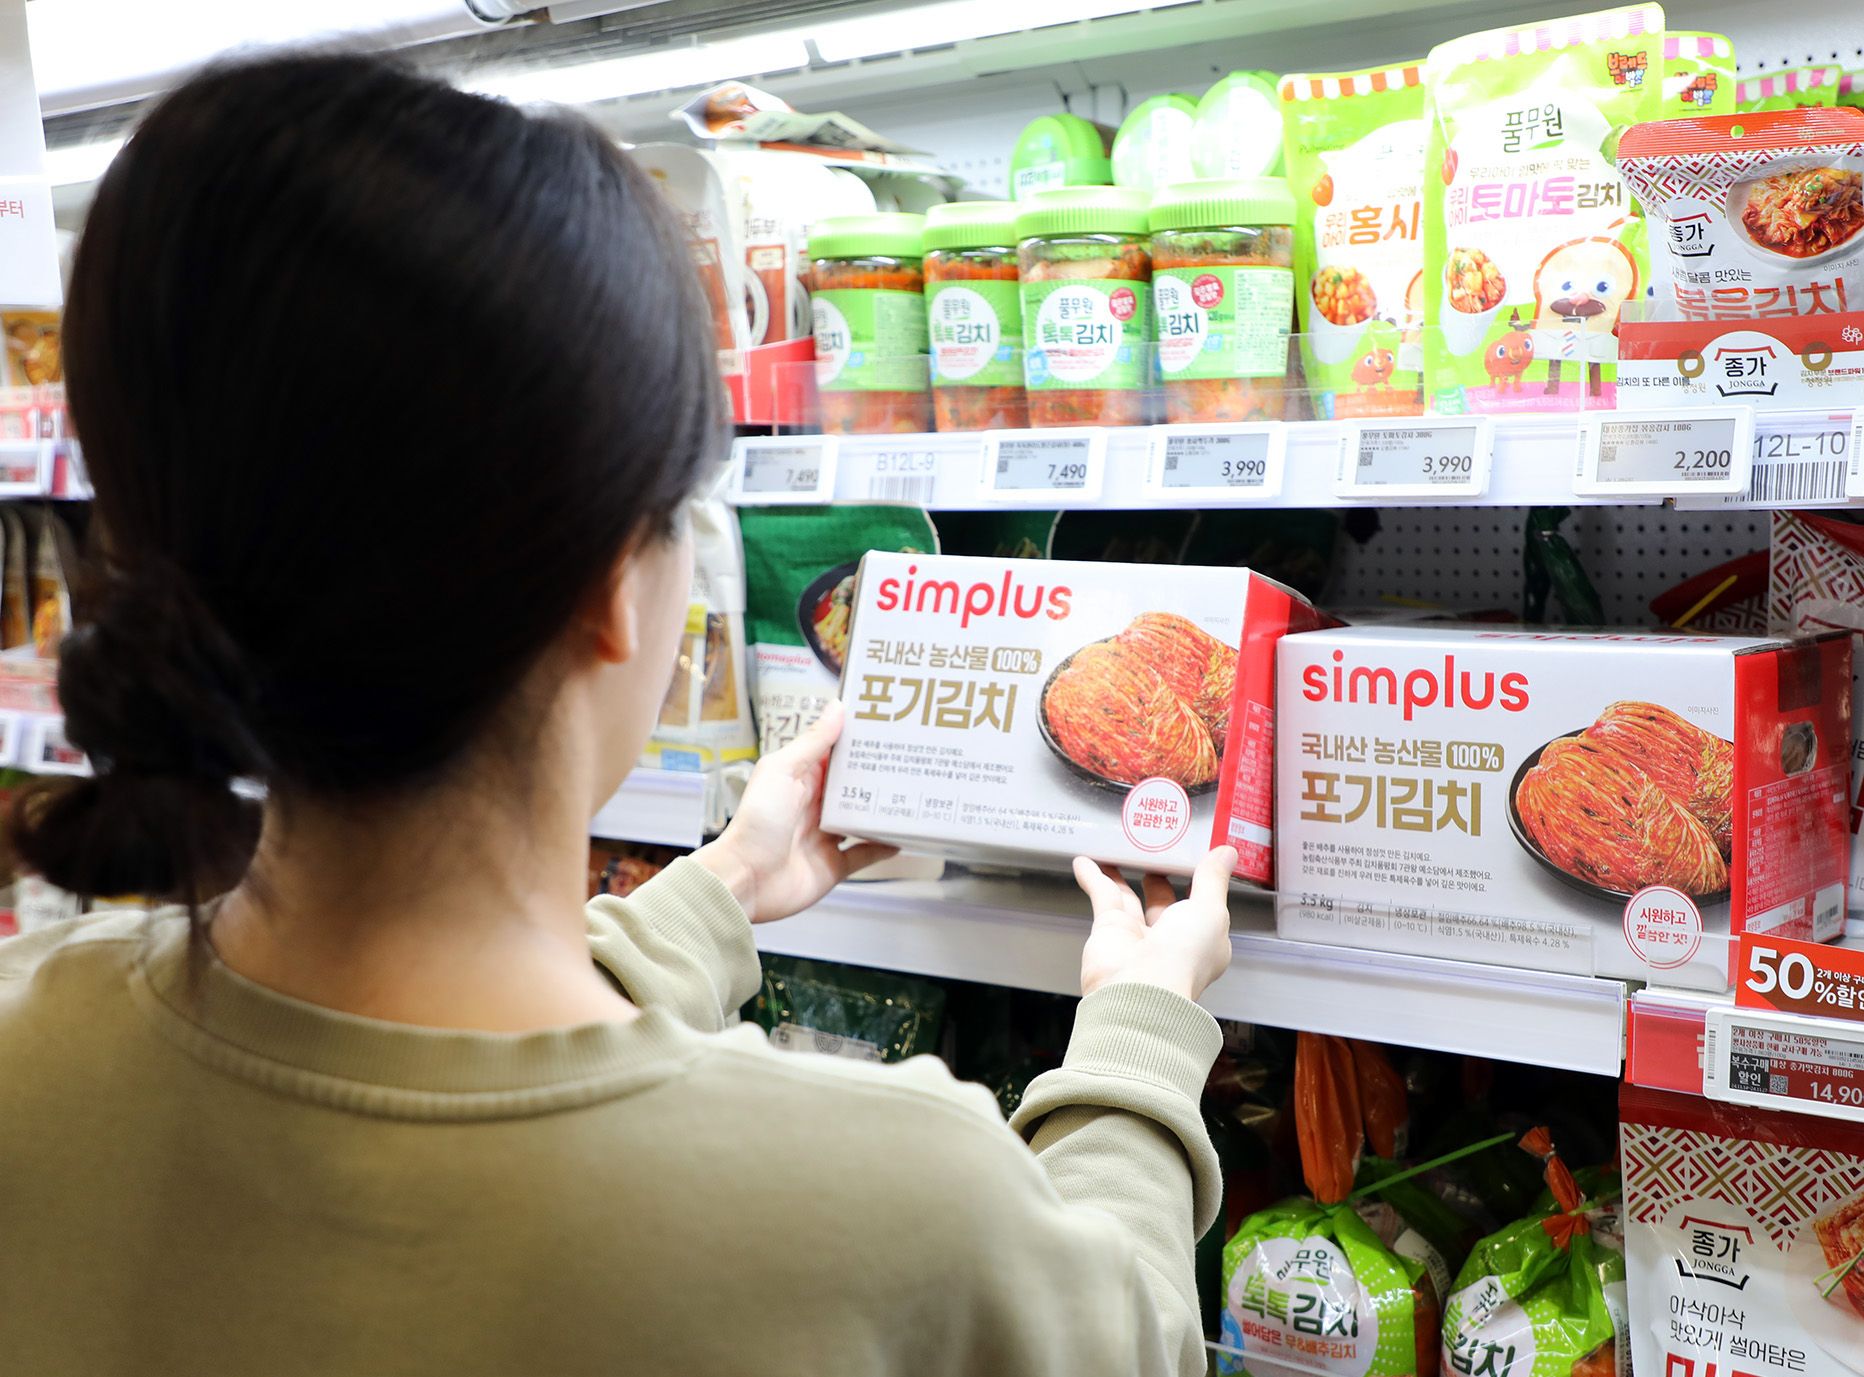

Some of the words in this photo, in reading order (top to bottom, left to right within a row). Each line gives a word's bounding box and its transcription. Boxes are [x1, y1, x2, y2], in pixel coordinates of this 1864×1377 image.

[1501, 103, 1563, 153] 풀무원
[1669, 222, 1705, 243] 종가
[1715, 267, 1753, 283] 맛있는
[1725, 356, 1767, 378] 종가
[1616, 376, 1640, 387] 김치의
[1642, 377, 1651, 387] 또
[1653, 377, 1672, 387] 다른
[1729, 379, 1766, 390] JONGGA
[876, 452, 935, 471] B12L-9
[1221, 460, 1266, 479] 3,990
[1422, 456, 1473, 476] 3,990
[1673, 450, 1731, 471] 2,200
[1048, 464, 1087, 480] 7,490
[876, 565, 1074, 629] simplus
[866, 639, 925, 666] 국내산
[928, 643, 990, 671] 농산물
[996, 648, 1037, 673] 100%
[1302, 648, 1530, 722] simplus
[854, 674, 1018, 734] 포기김치
[1301, 732, 1368, 763] 국내산
[1373, 736, 1443, 769] 농산물
[1451, 744, 1500, 769] 100%
[841, 786, 857, 799] 3.5
[858, 788, 872, 803] kg
[1136, 797, 1178, 812] 시원하고
[1300, 770, 1482, 837] 포기김치
[1132, 811, 1163, 829] 깔끔한
[1165, 814, 1179, 831] 맛!
[1302, 841, 1315, 850] 좋은
[1316, 842, 1336, 853] 배추를
[1337, 845, 1364, 856] 사용하여
[1387, 849, 1401, 859] 만든
[1302, 853, 1347, 866] 농림축산식품부
[1348, 858, 1363, 867] 주최
[1363, 859, 1398, 871] 김치품평회
[1399, 863, 1417, 873] 7관왕
[1418, 865, 1454, 877] 예소담에서
[1316, 867, 1336, 877] 재료를
[1337, 868, 1358, 880] 진하게
[1359, 871, 1372, 881] 우려
[1373, 873, 1388, 883] 만든
[1389, 874, 1424, 887] 특제육수를
[1425, 878, 1440, 888] 넣어
[1440, 880, 1455, 890] 깊은
[1299, 893, 1317, 907] 3.5
[1319, 894, 1334, 911] kg
[1299, 910, 1314, 921] (980
[1316, 911, 1334, 922] kcal)
[1343, 915, 1385, 930] (비살균제품)
[1639, 907, 1687, 925] 시원하고
[1437, 924, 1463, 937] 식염1.5
[1509, 933, 1540, 946] 특제육수
[1542, 937, 1561, 949] 4.28
[1562, 940, 1571, 950] %
[1745, 945, 1814, 1000] 50
[1816, 968, 1832, 980] 2개
[1833, 972, 1851, 983] 이상
[1748, 1029, 1764, 1040] 이상
[1730, 1055, 1770, 1073] 복수구매
[1770, 1059, 1787, 1070] 대상
[1789, 1061, 1830, 1076] 종가맛김치
[1832, 1067, 1854, 1079] 800G
[1738, 1070, 1761, 1087] 할인
[1810, 1081, 1864, 1105] 14,90
[1692, 1228, 1741, 1264] 종가
[1692, 1257, 1736, 1277] JONGGA
[1669, 1294, 1746, 1331] 아삭아삭
[1670, 1319, 1724, 1352] 맛있게
[1729, 1334, 1807, 1373] 썰어담은
